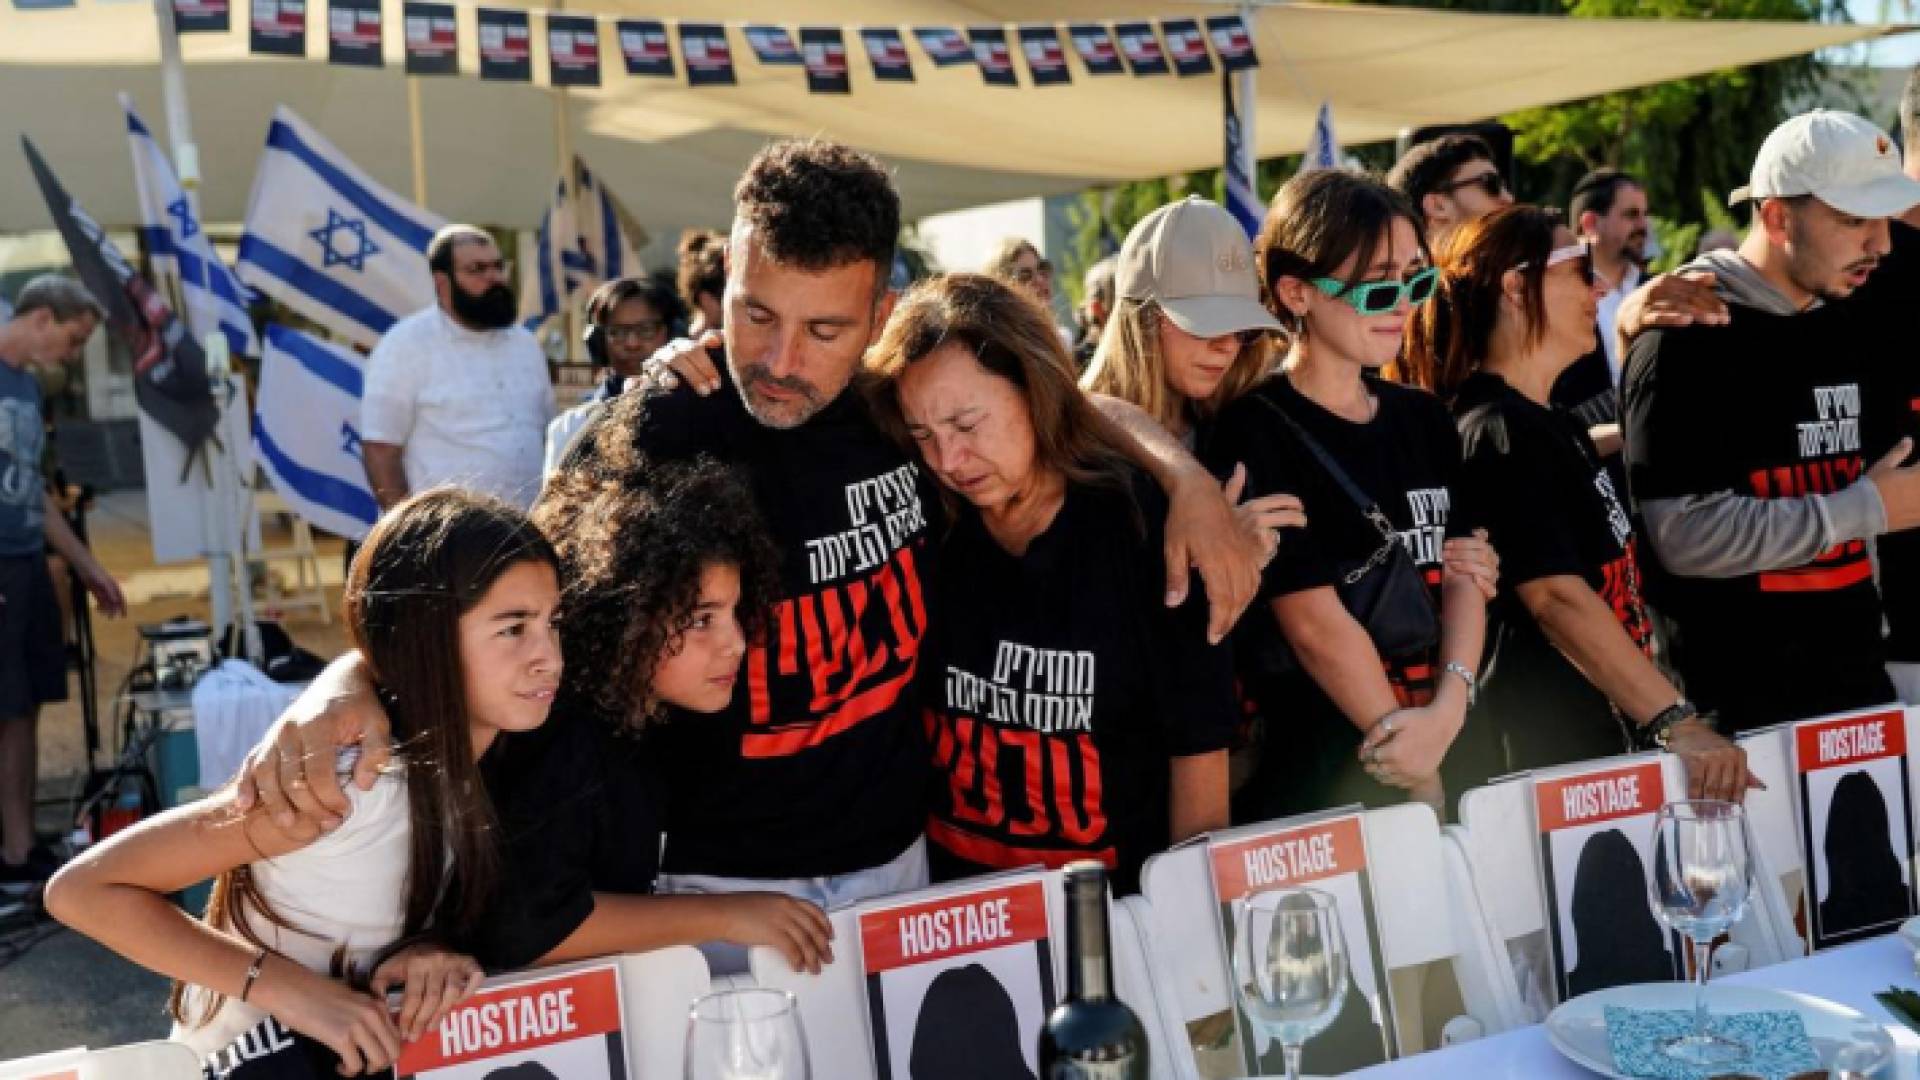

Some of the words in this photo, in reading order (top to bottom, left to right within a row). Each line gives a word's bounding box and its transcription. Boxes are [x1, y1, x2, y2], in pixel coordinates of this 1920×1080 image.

[804, 523, 889, 584] הביתה
[946, 664, 1020, 724] הביתה
[993, 640, 1095, 694] מחזירים
[1024, 692, 1095, 732] אותם
[1818, 720, 1887, 762] HOSTAGE
[1562, 775, 1642, 821] HOSTAGE
[1244, 832, 1338, 889] HOSTAGE
[900, 898, 1013, 957] HOSTAGE
[439, 988, 577, 1057] HOSTAGE
